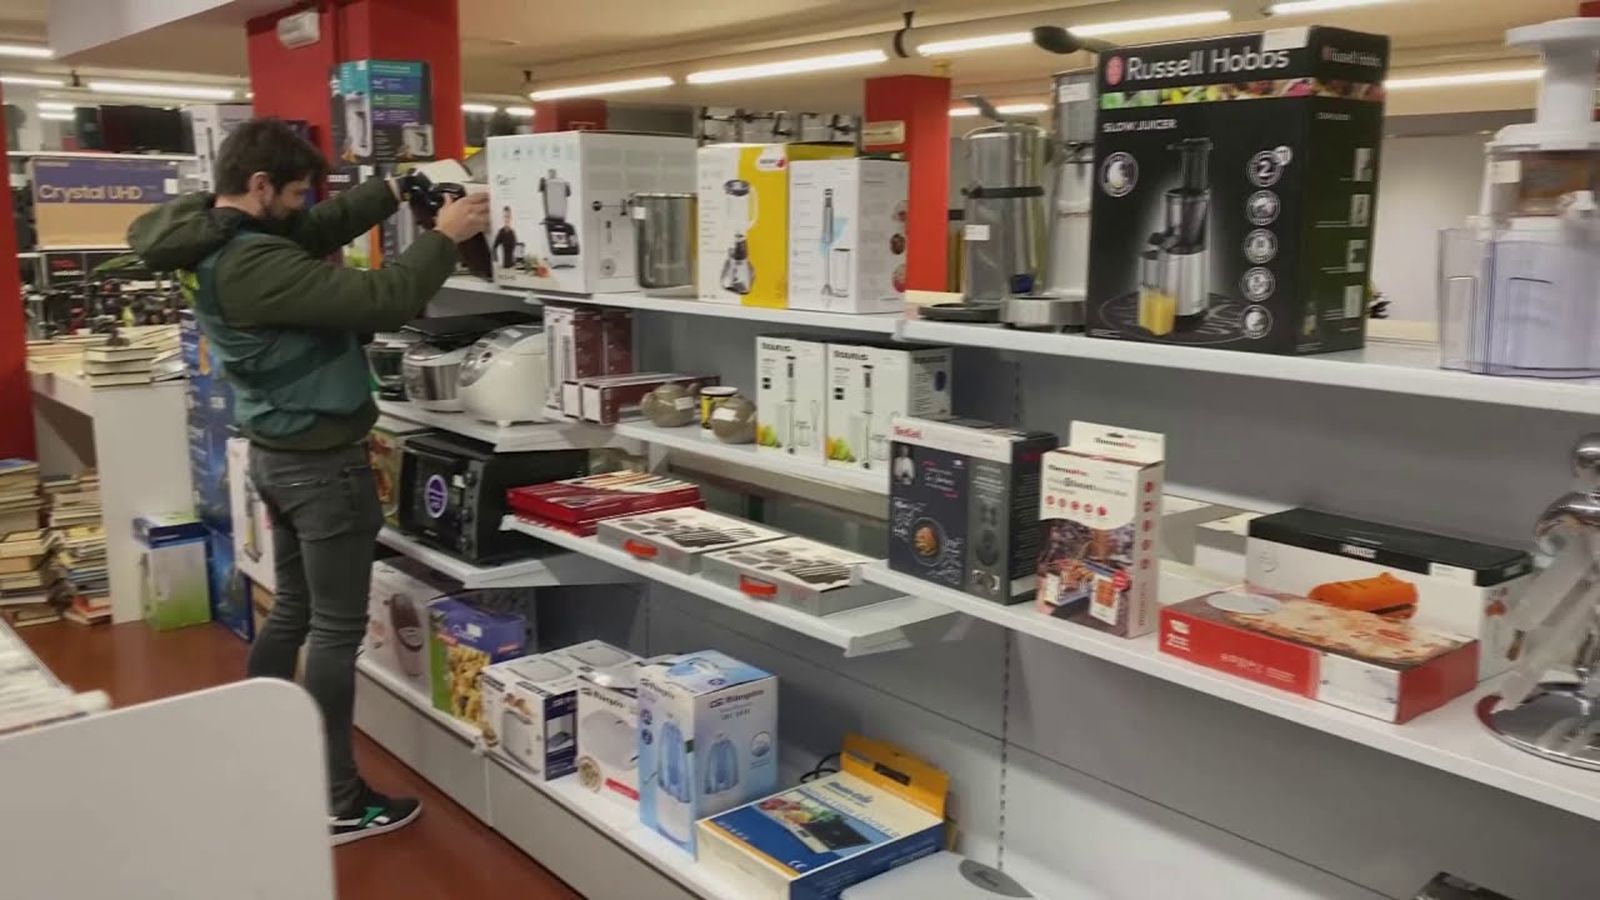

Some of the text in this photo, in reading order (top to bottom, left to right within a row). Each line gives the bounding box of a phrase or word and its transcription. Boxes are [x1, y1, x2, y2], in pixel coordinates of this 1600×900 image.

[1126, 46, 1289, 81] Russell Hobbs
[1259, 160, 1274, 177] 2
[40, 184, 142, 203] Crystal UHD
